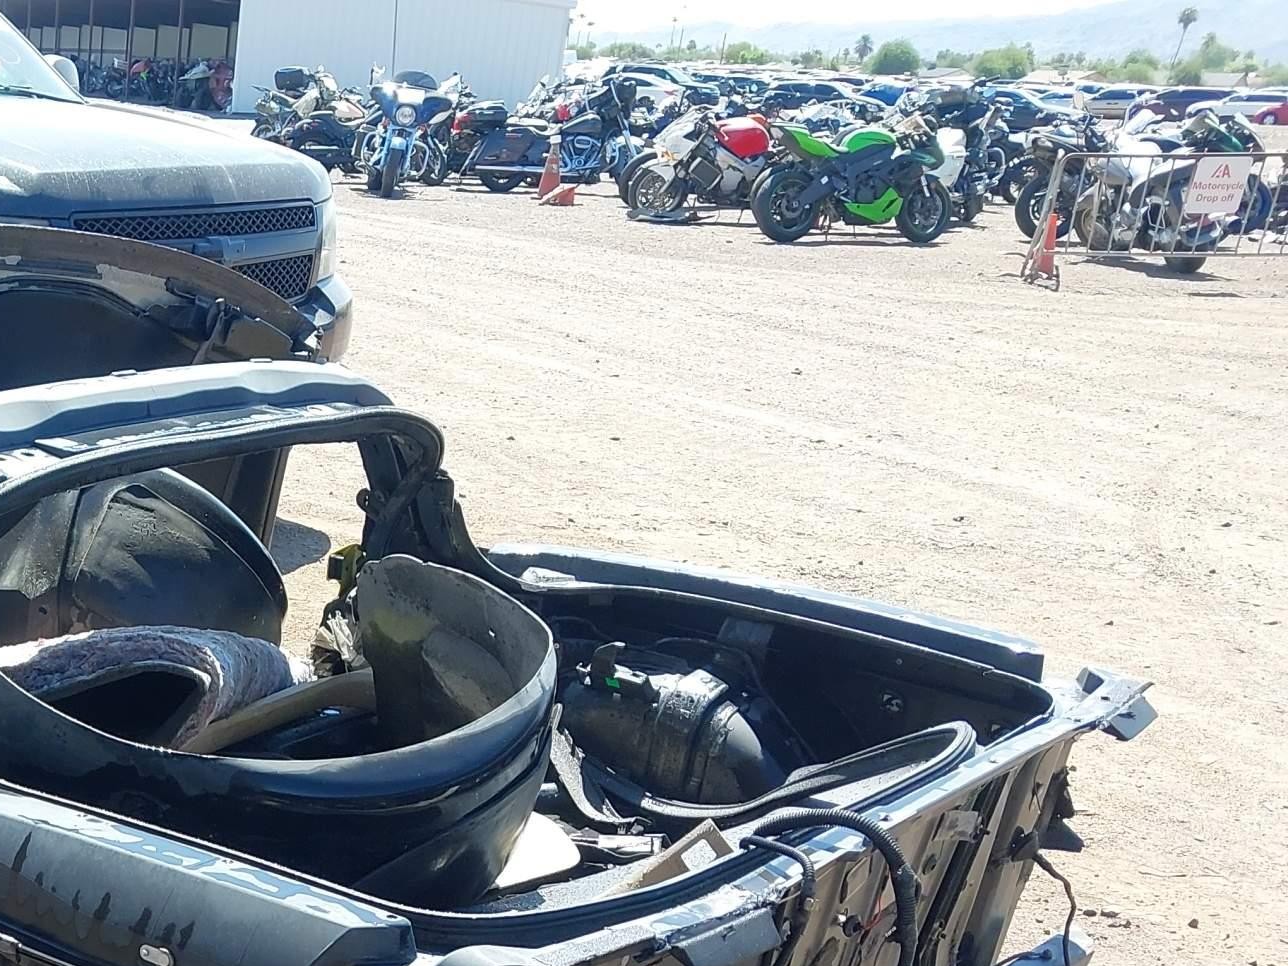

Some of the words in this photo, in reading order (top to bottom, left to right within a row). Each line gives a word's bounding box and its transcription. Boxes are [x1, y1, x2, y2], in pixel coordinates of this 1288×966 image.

[1192, 181, 1244, 191] Motorcycle
[1196, 193, 1218, 203] Drop
[1221, 193, 1235, 203] off
